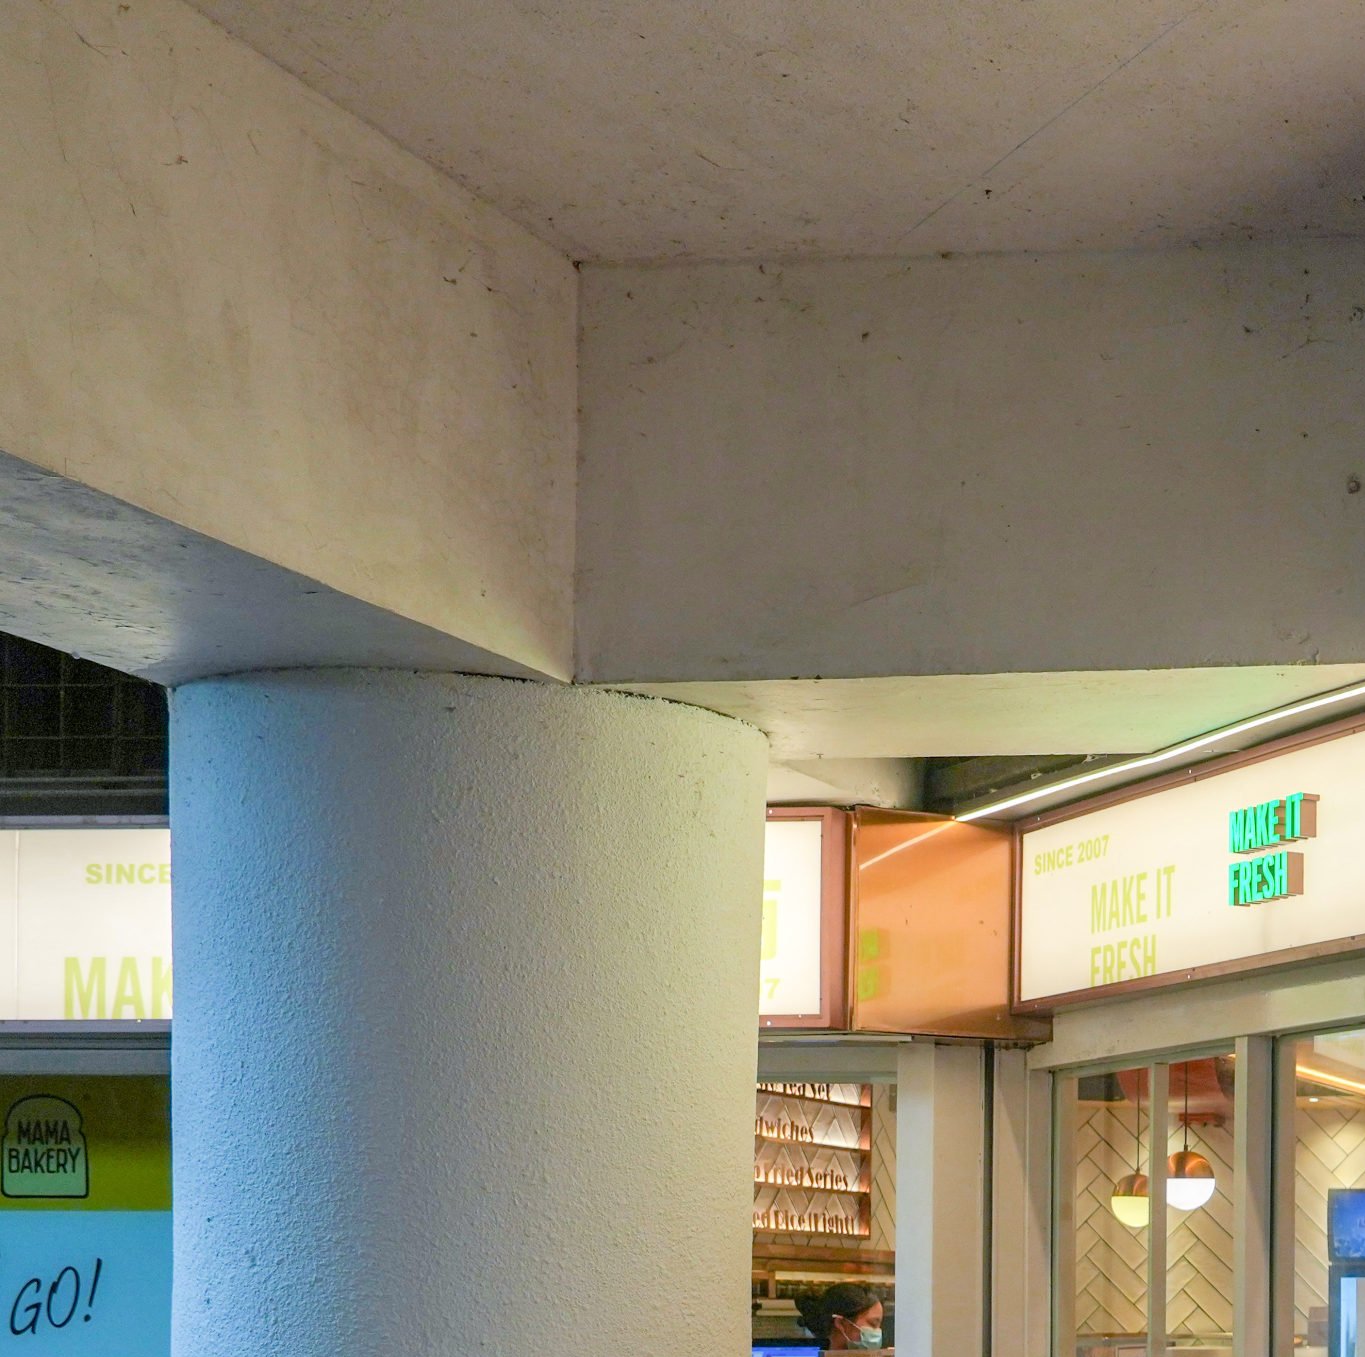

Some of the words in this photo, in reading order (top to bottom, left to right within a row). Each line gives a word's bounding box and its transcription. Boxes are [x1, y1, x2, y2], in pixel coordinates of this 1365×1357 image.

[1228, 799, 1280, 852] MAKE
[1285, 792, 1304, 839] IT
[1034, 845, 1073, 875] SINCE
[1077, 835, 1110, 864] 2007
[1228, 851, 1289, 906] FRESH
[1091, 872, 1148, 934] MAKE
[1156, 865, 1176, 919] IT
[1090, 934, 1157, 987] FRESH
[17, 1120, 71, 1146] MAMA
[8, 1148, 80, 1174] BAKERY
[10, 1258, 102, 1335] GO!
